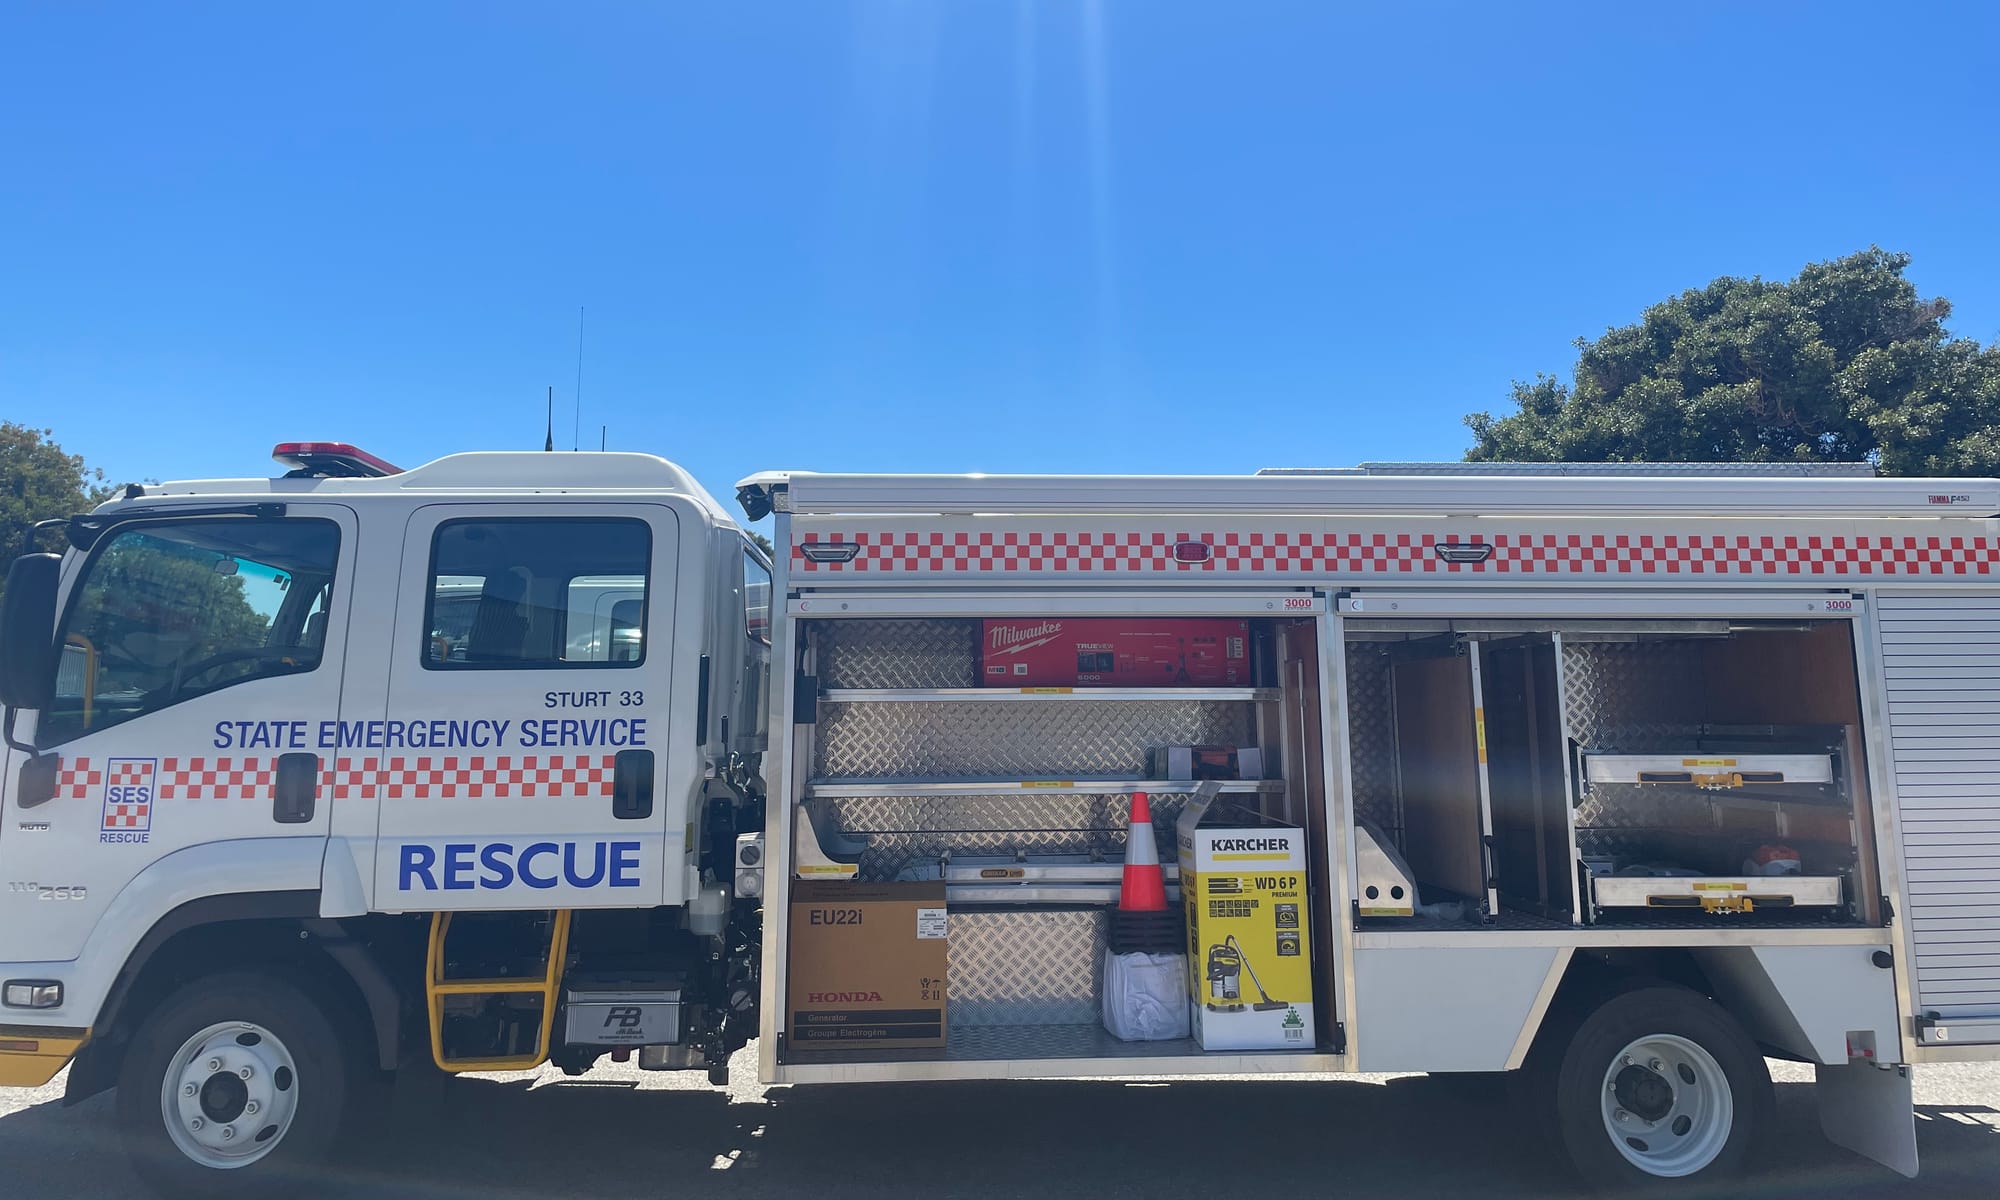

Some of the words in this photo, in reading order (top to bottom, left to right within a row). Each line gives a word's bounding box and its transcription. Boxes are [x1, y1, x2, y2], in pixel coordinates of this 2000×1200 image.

[1284, 598, 1312, 608] 3000
[1825, 600, 1852, 609] 3000
[989, 621, 1063, 649] Milwaukee
[544, 691, 611, 708] STURT
[619, 690, 644, 706] 33
[213, 720, 308, 749] STATE
[317, 719, 511, 748] EMERGENCY
[519, 718, 647, 747] SERVICE
[108, 786, 149, 803] SES
[20, 823, 50, 831] AUTO
[100, 833, 150, 844] RESCUE
[1211, 838, 1289, 851] KÄRCHER
[399, 841, 641, 891] RESCUE
[1255, 877, 1277, 890] WD
[1278, 877, 1287, 889] 6
[1289, 877, 1297, 889] P
[810, 909, 862, 925] EU22i
[808, 992, 882, 1003] HONDA
[603, 1006, 643, 1028] FB
[808, 1014, 847, 1022] Generator
